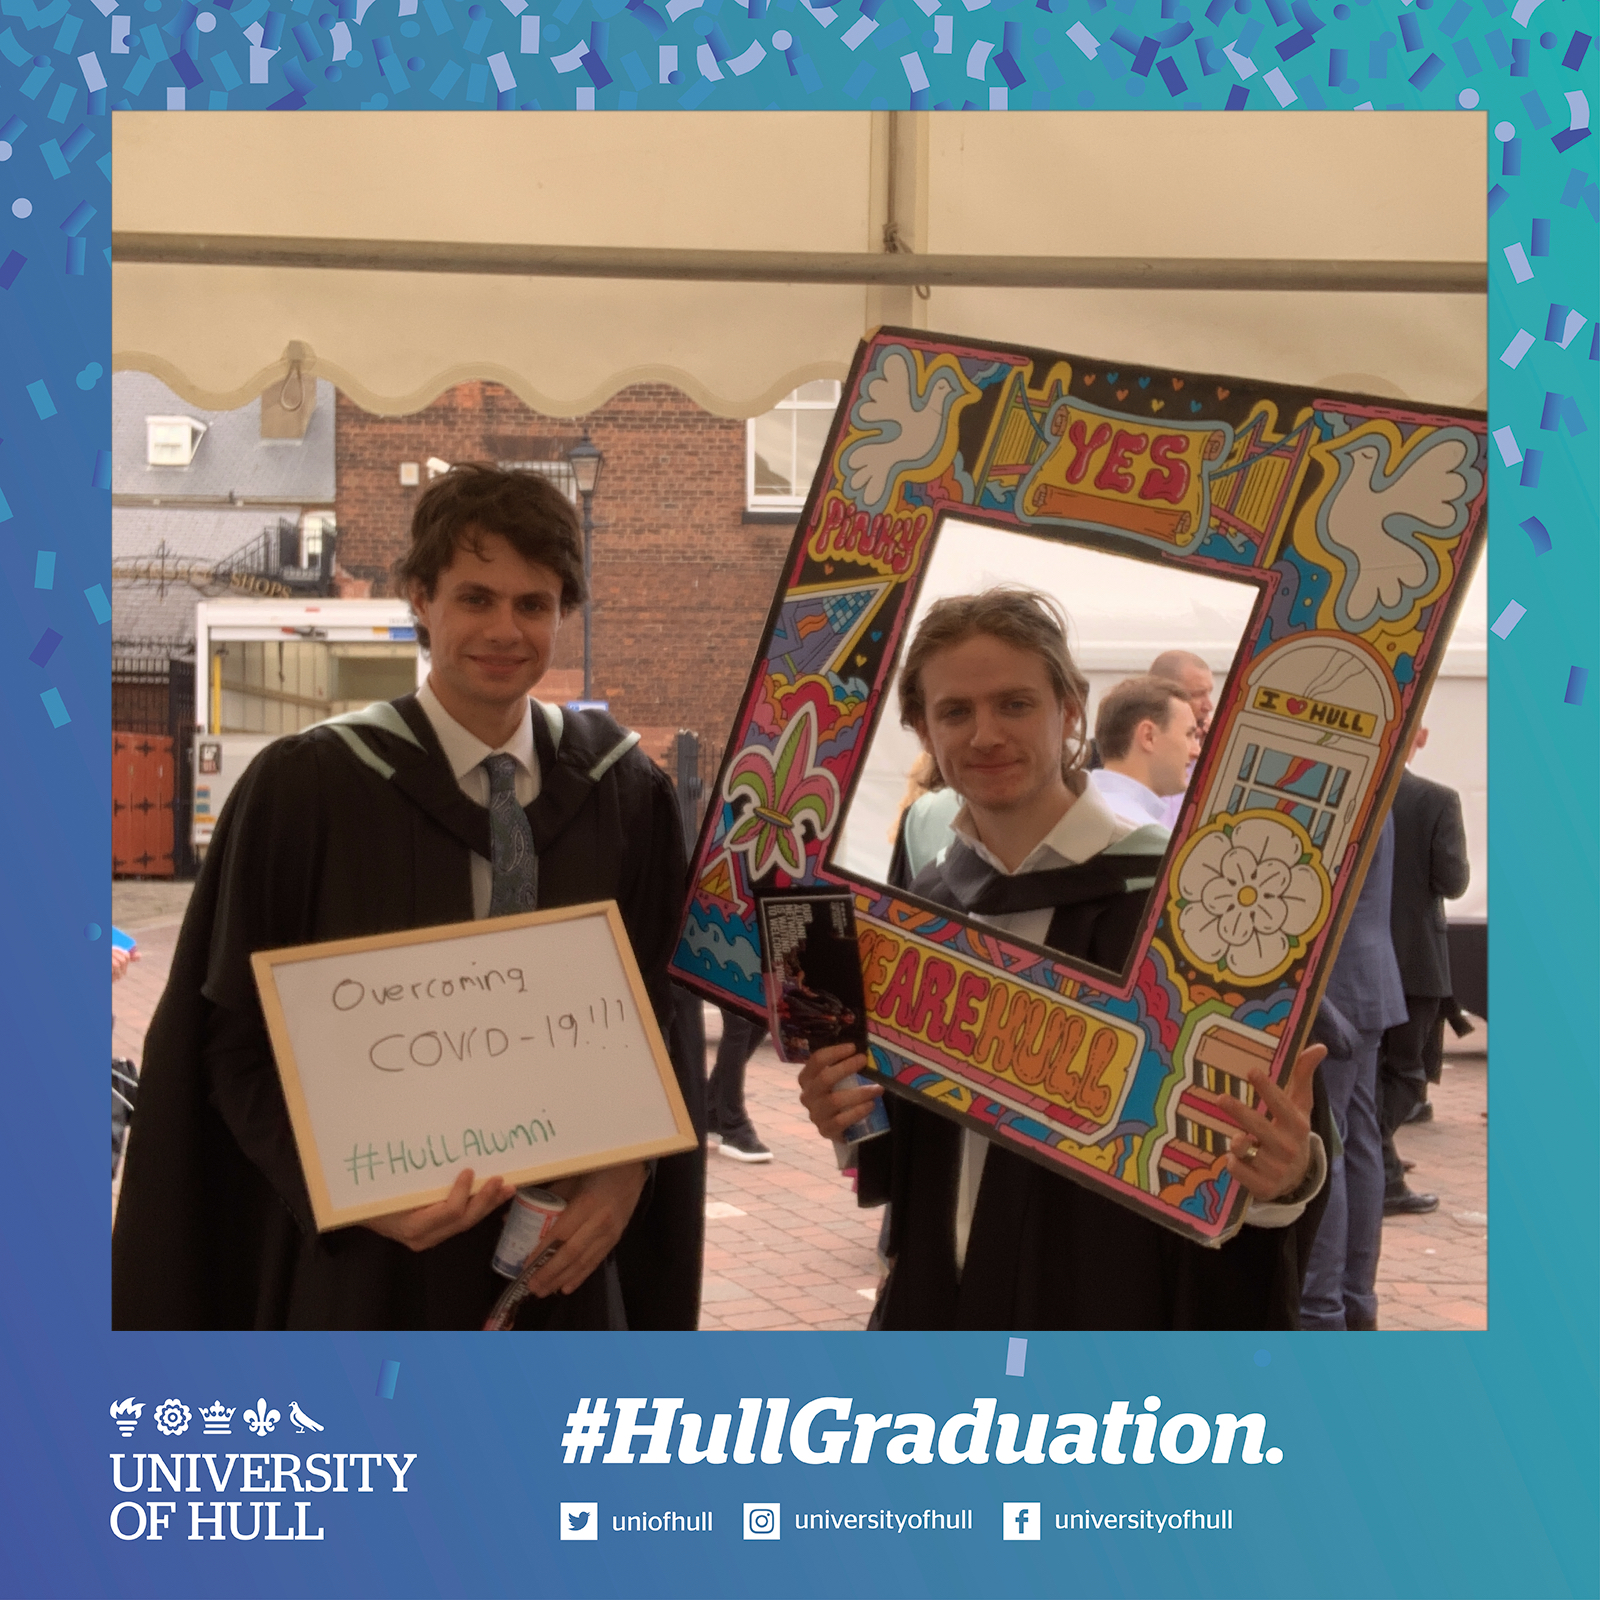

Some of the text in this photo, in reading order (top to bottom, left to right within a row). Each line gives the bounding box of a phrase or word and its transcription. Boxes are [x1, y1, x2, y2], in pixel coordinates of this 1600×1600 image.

[1065, 418, 1191, 504] YES
[229, 571, 293, 598] SHOPS
[1258, 690, 1364, 733] I HULL
[777, 916, 791, 953] WAITING
[785, 904, 800, 948] NETWORK
[793, 903, 807, 939] ALUMNI
[801, 903, 813, 924] OUR
[769, 918, 784, 962] WELCOME
[332, 961, 528, 1011] Overcoming
